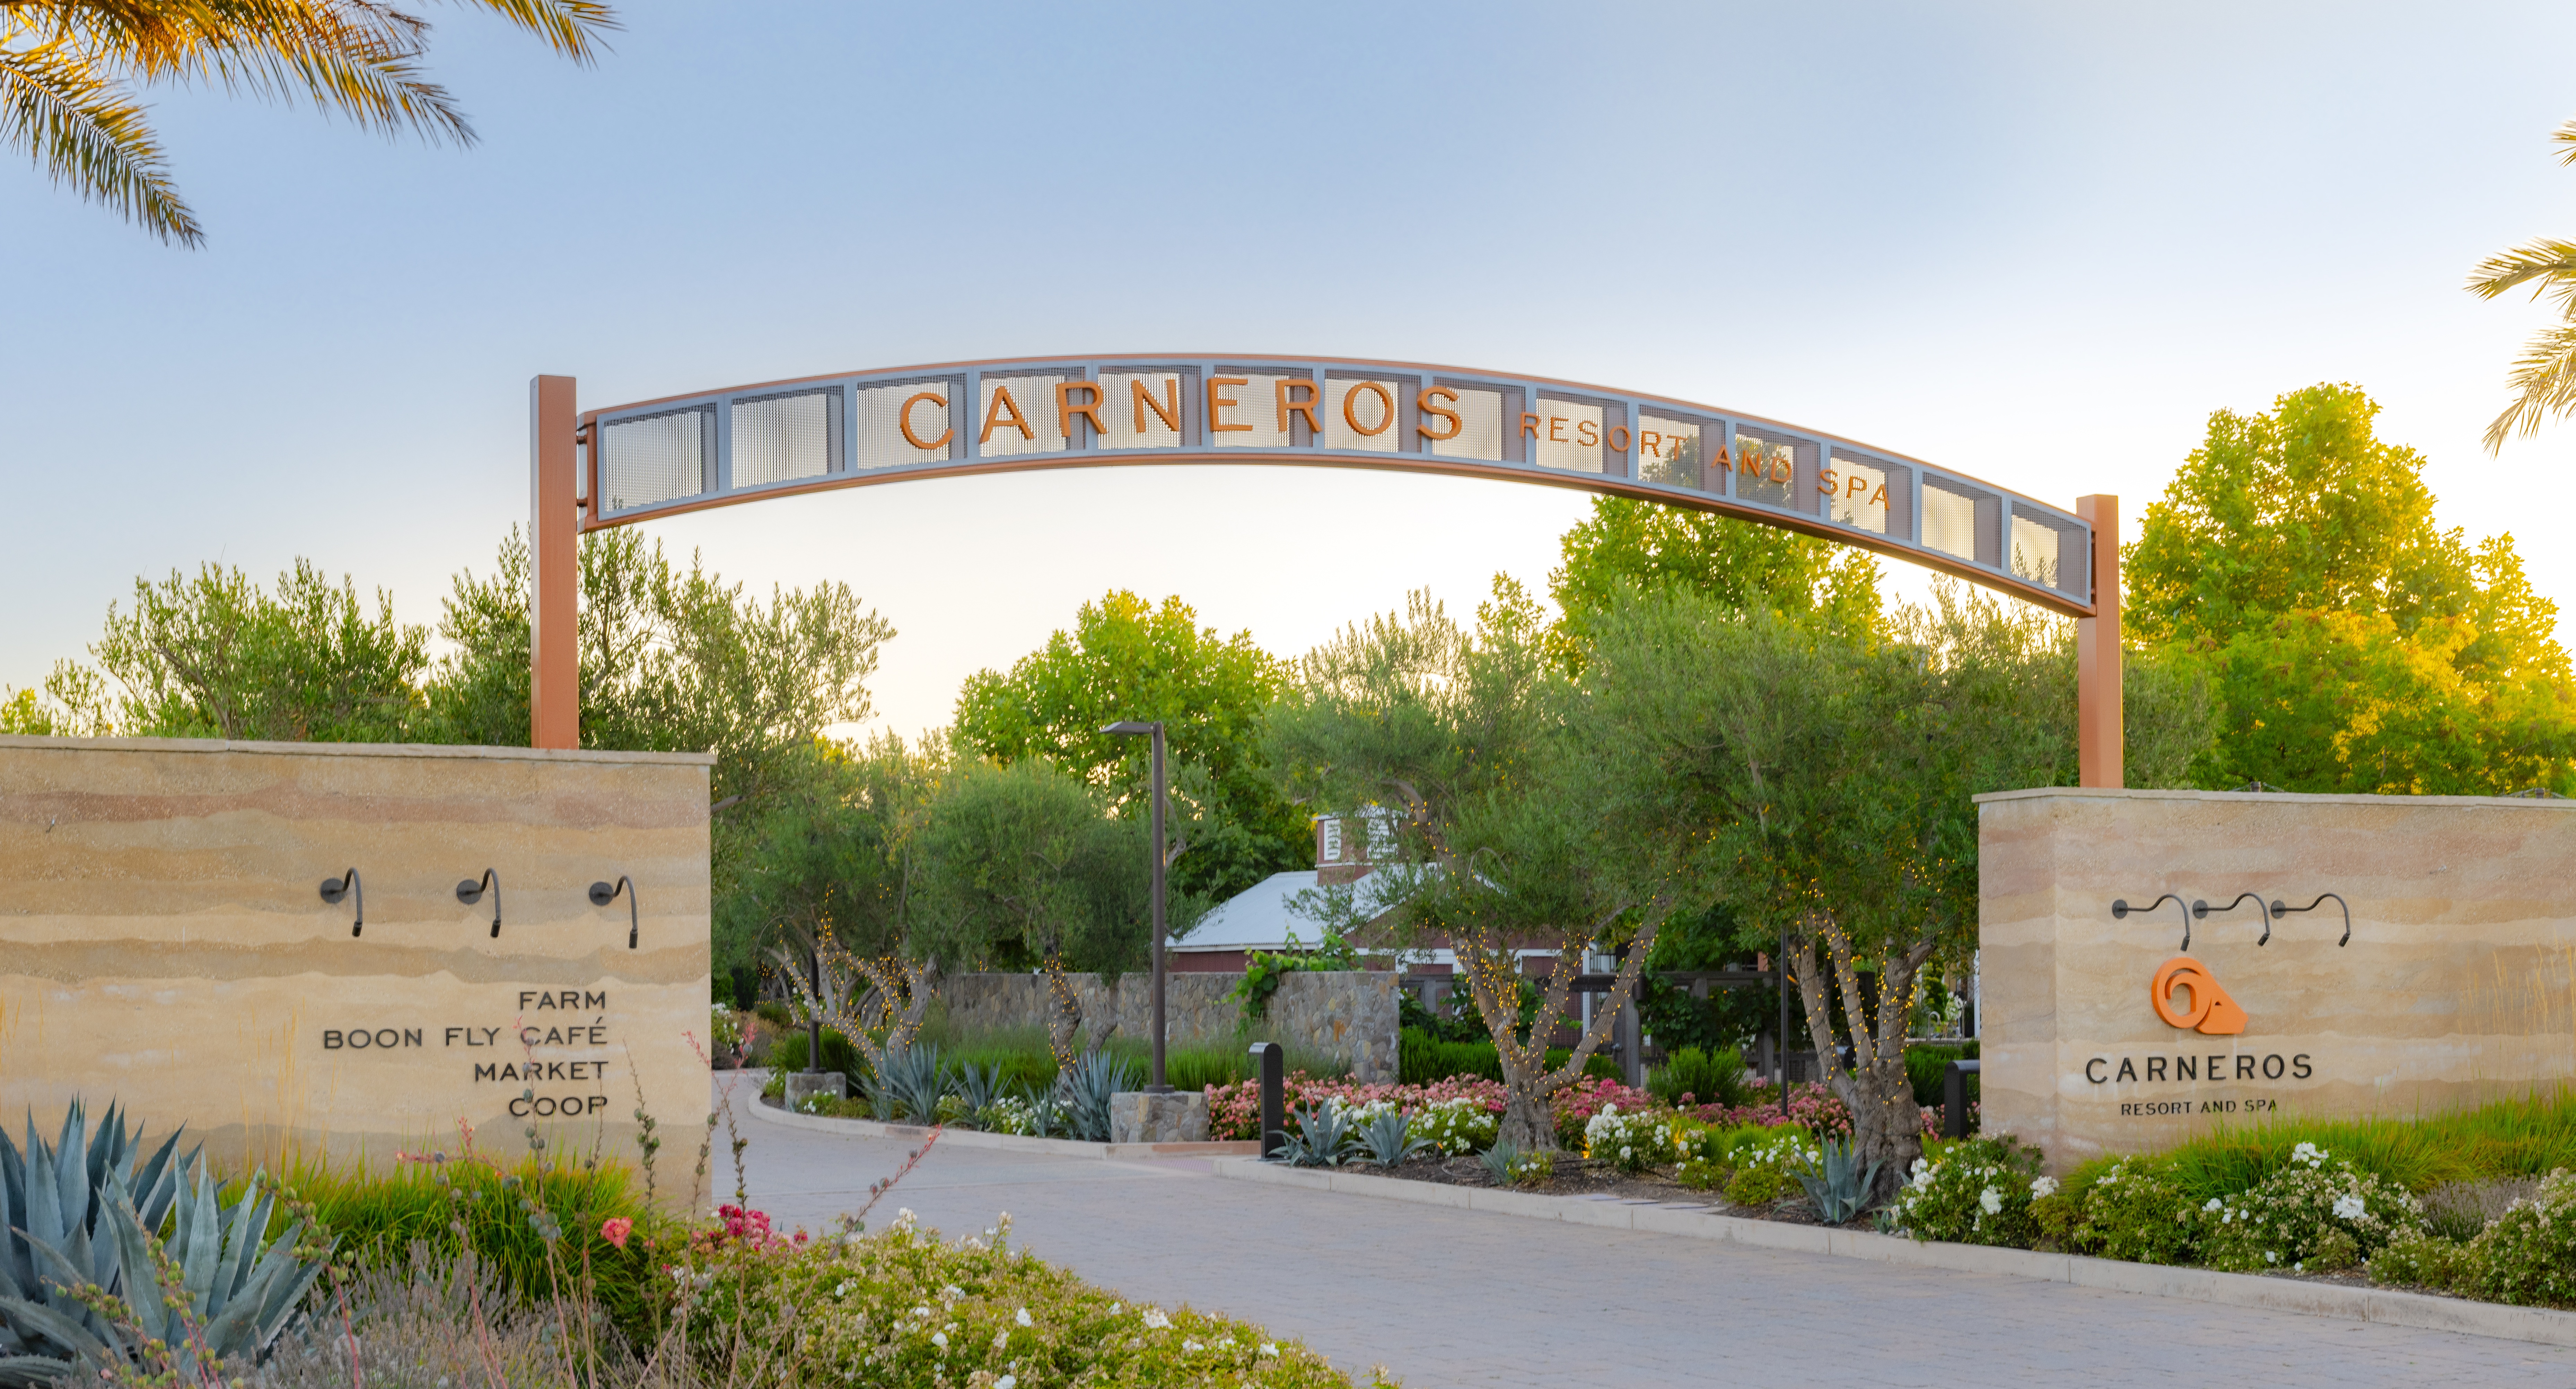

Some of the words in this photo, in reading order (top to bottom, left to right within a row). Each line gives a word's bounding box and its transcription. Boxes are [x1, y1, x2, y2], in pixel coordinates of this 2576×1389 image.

[900, 377, 1462, 450] CARNEROS
[1520, 412, 1687, 461] RESORT
[1711, 445, 1792, 483] AND
[1819, 469, 1890, 510] SPA
[520, 991, 605, 1010] FARM
[324, 1028, 422, 1049] BOON
[446, 1028, 500, 1046] FLY
[520, 1017, 607, 1045] CAFÉ
[475, 1061, 608, 1081] MARKET
[2086, 1054, 2312, 1084] CARNEROS
[509, 1097, 608, 1116] COOP
[2121, 1101, 2192, 1115] RESORT
[2200, 1101, 2236, 1113] AND
[2244, 1100, 2277, 1111] SPA
